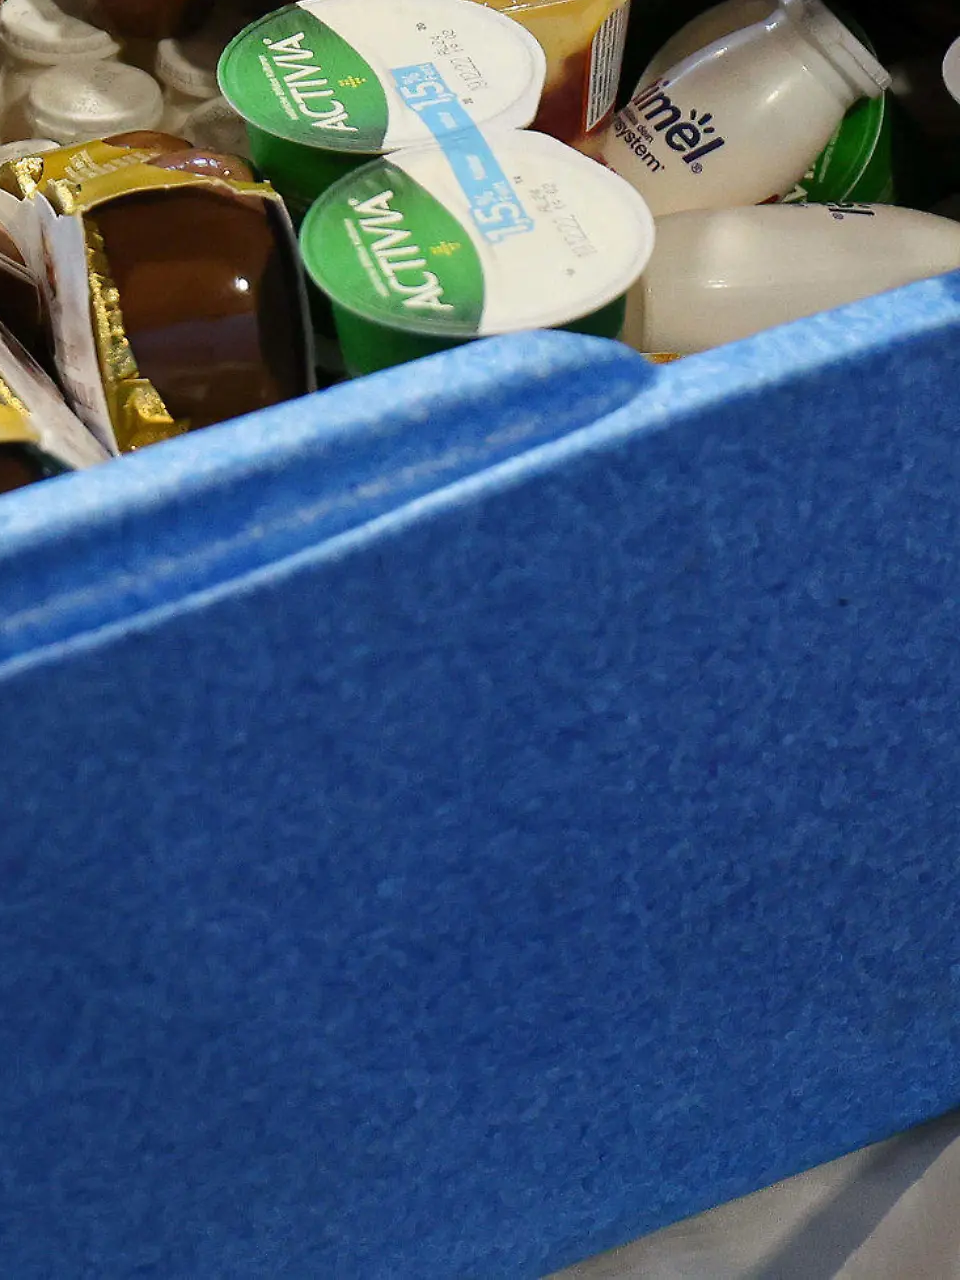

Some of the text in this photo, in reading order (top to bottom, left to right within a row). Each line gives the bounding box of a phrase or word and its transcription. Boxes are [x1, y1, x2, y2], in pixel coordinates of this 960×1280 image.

[267, 31, 359, 132] ACTIVIA
[629, 78, 725, 164] imel
[345, 189, 455, 312] ACTIVIA
